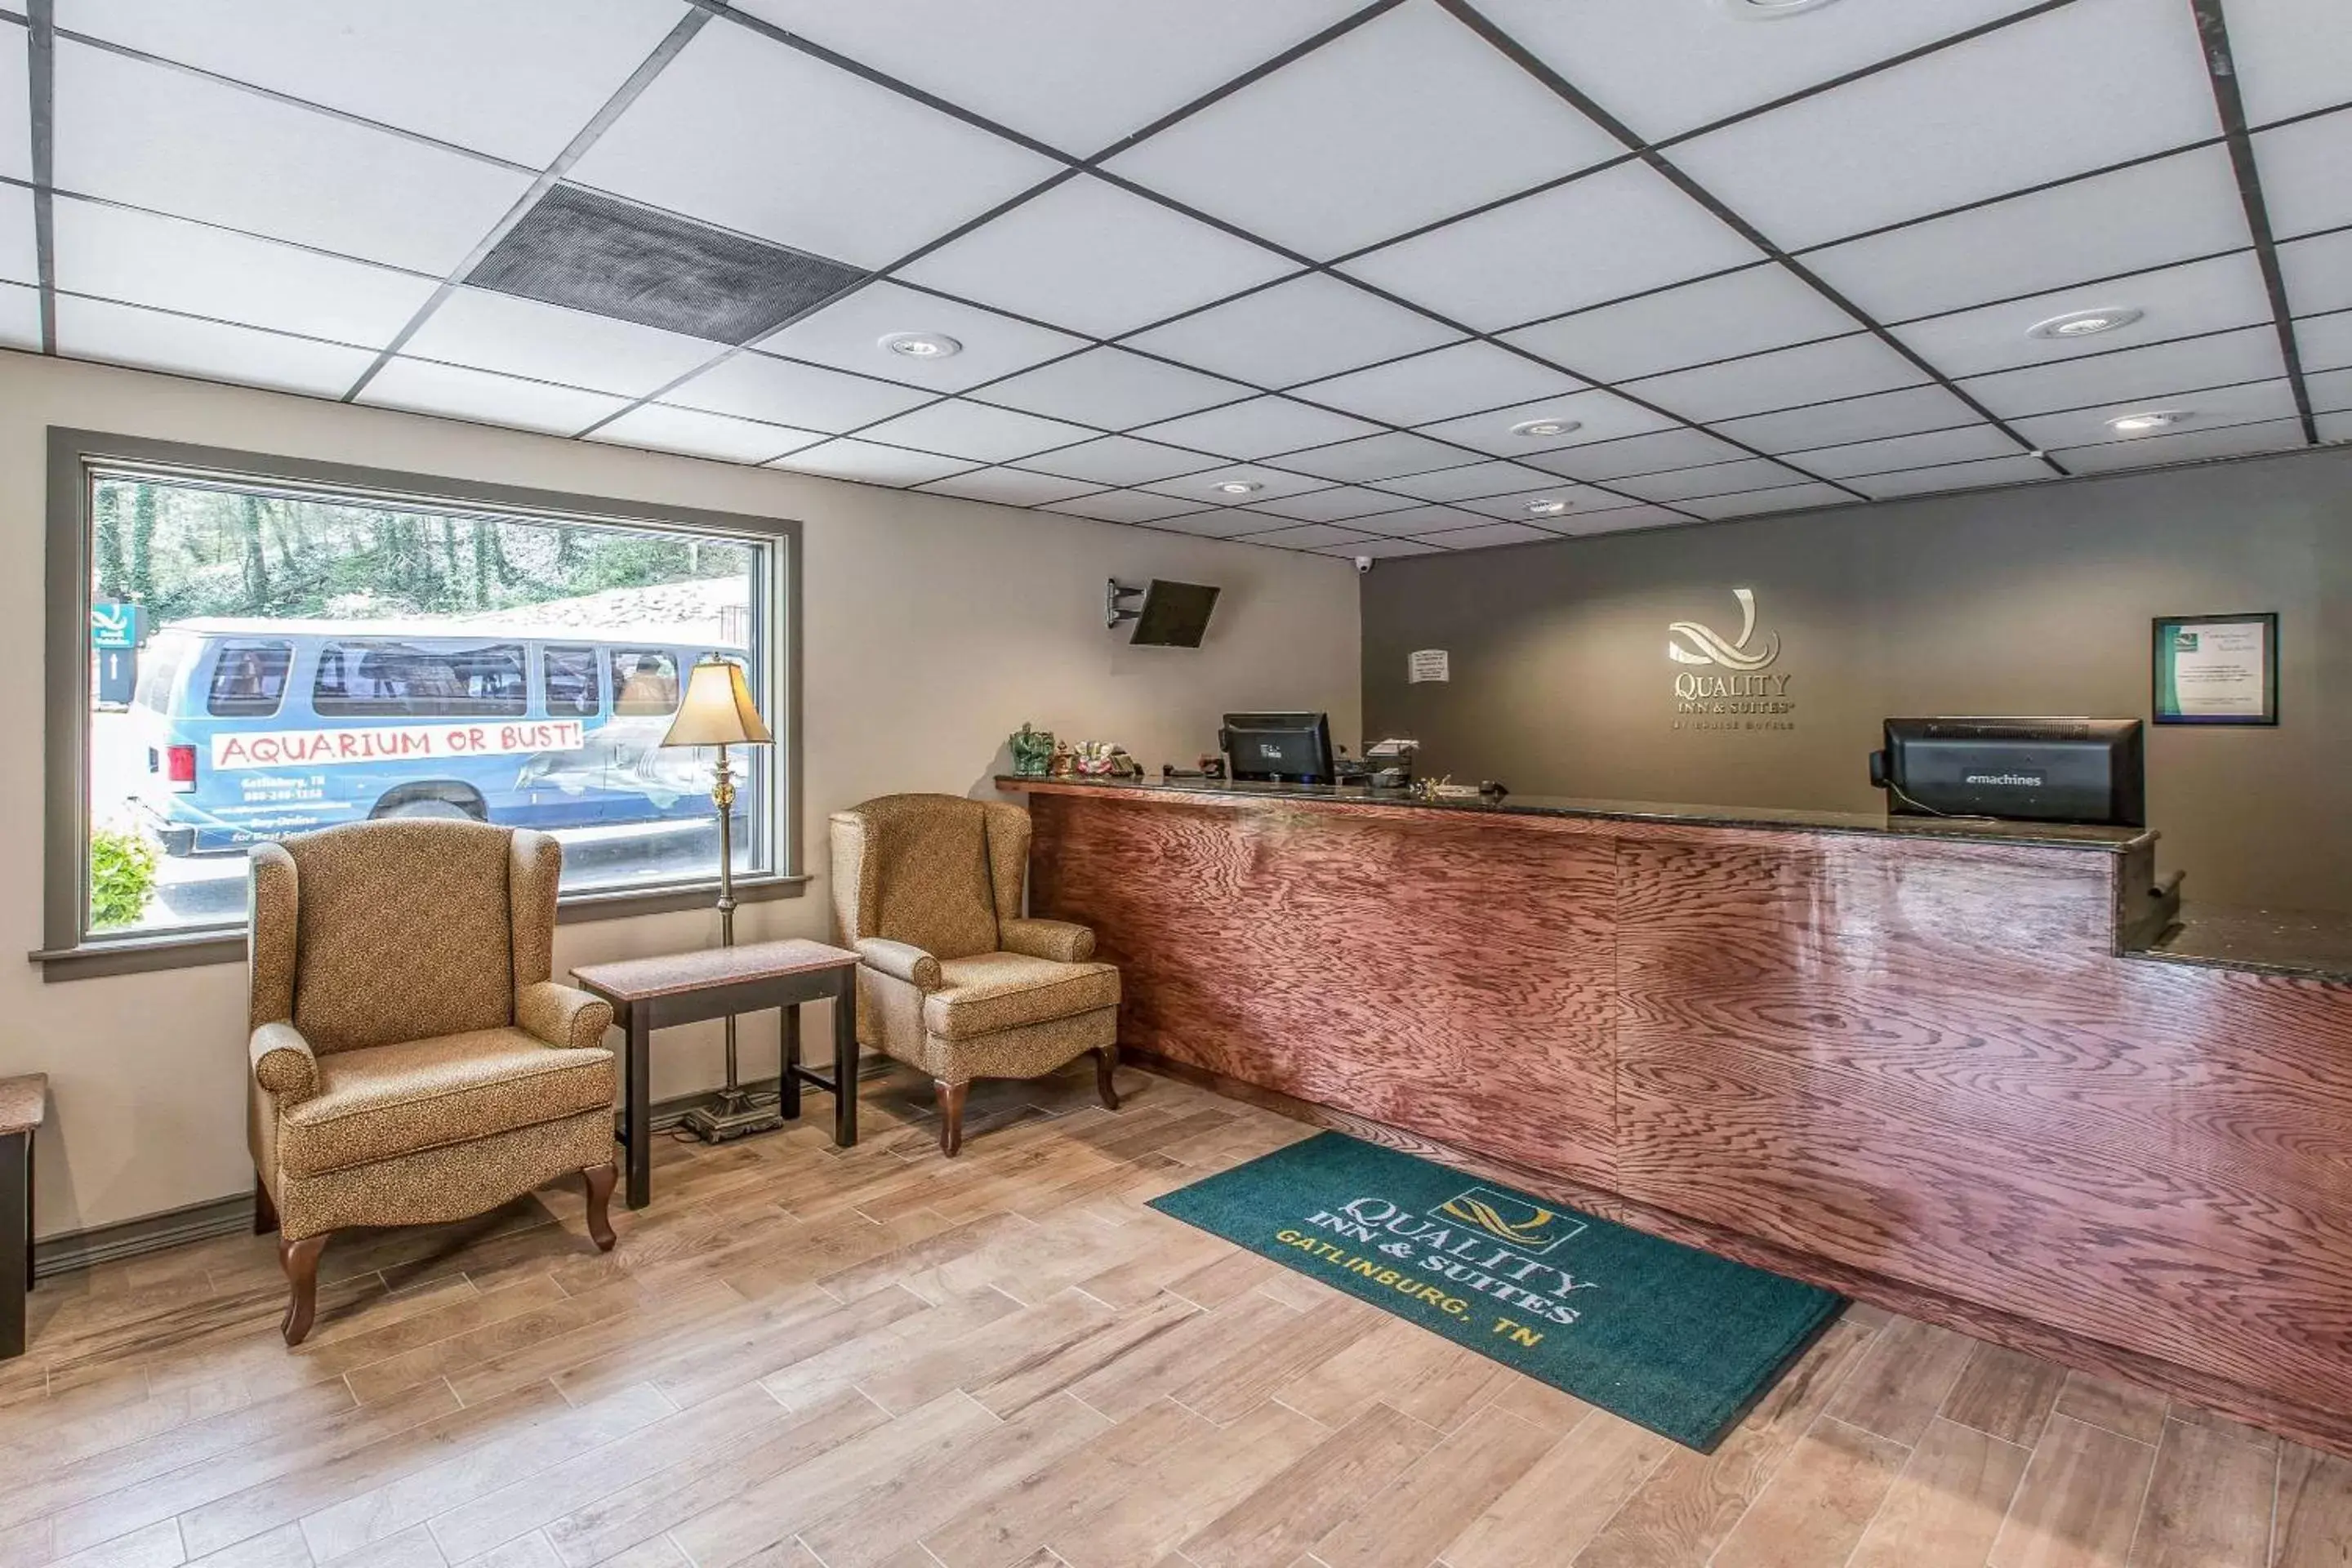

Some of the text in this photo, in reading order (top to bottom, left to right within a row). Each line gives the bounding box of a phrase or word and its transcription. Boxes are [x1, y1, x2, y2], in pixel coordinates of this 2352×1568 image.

[1675, 672, 1791, 700] QUALITY
[1678, 702, 1790, 715] INN & SUITES
[220, 722, 581, 765] AQUARIUM OR BUST!
[1966, 774, 2042, 786] emachines
[1305, 1210, 1581, 1325] INN & SUITES
[1337, 1196, 1601, 1299] QUALITY
[1276, 1229, 1544, 1348] GATLINBURG, TN
